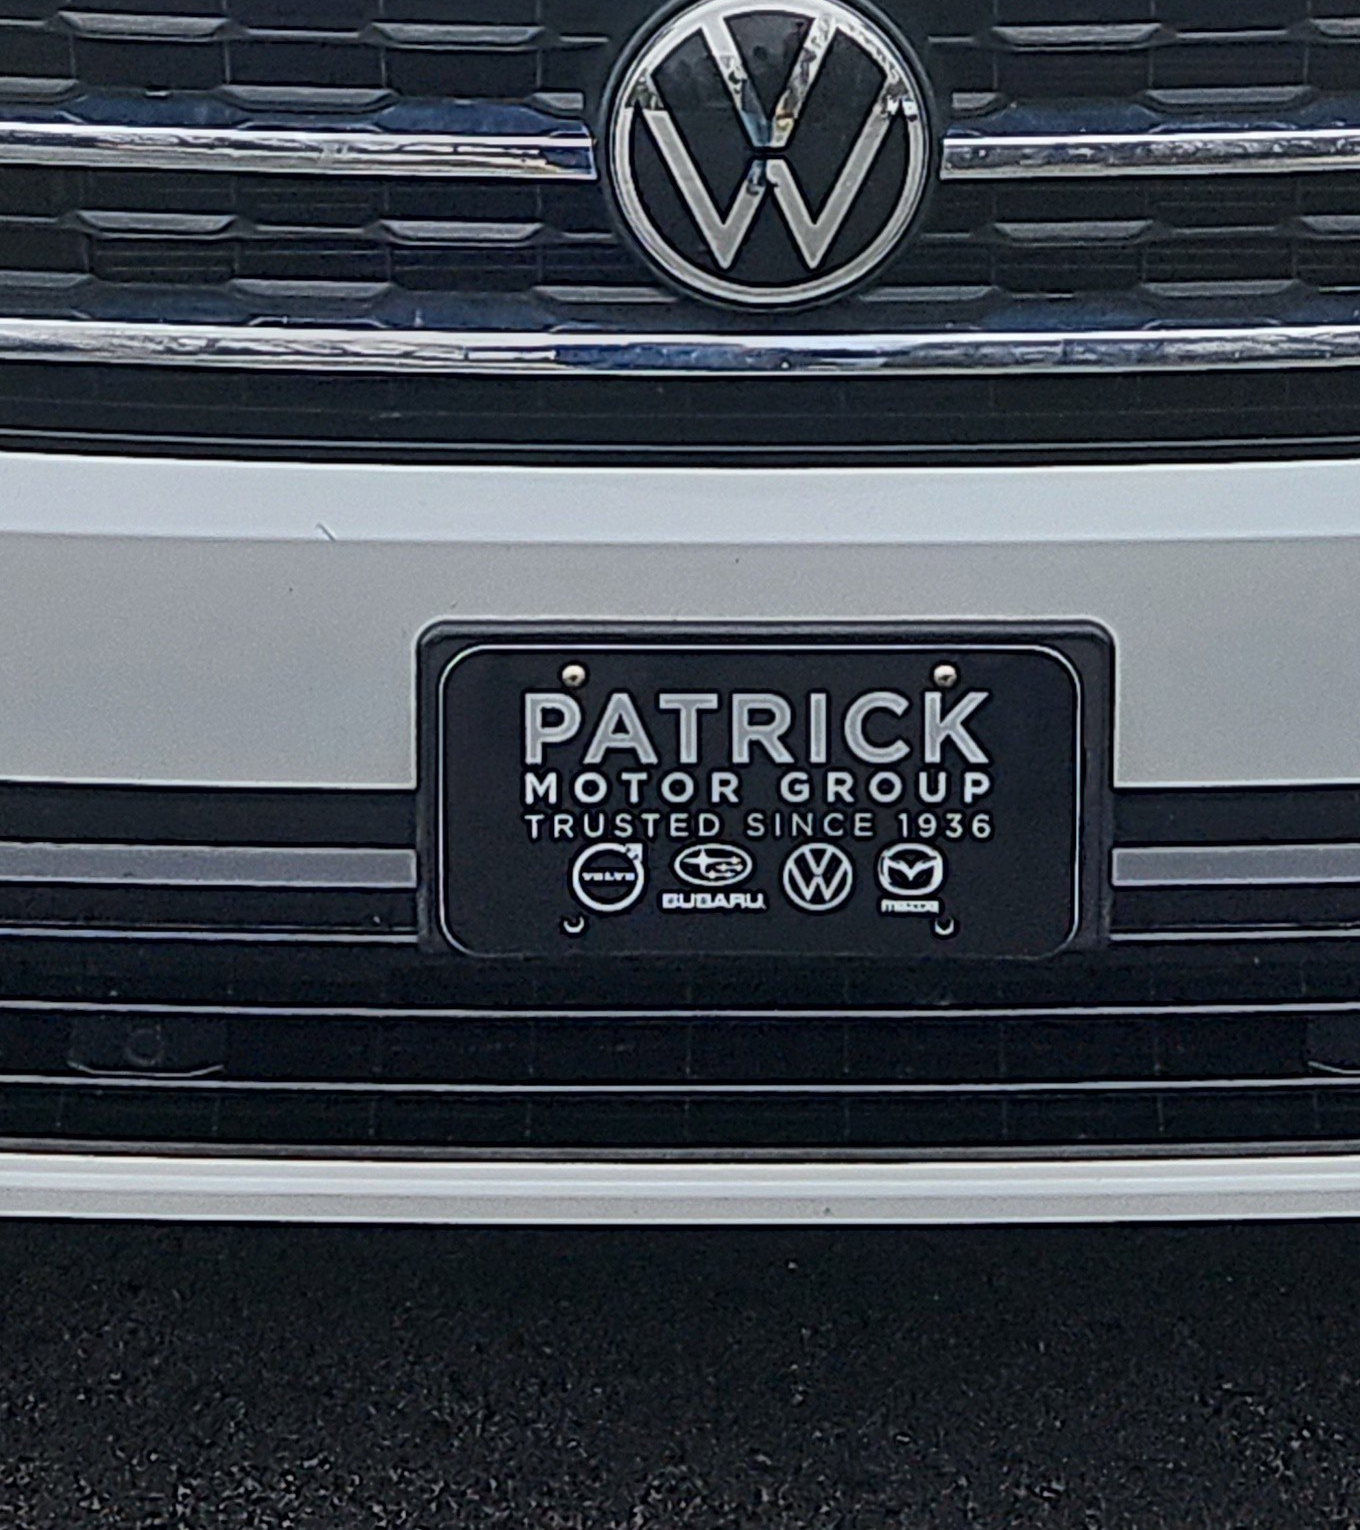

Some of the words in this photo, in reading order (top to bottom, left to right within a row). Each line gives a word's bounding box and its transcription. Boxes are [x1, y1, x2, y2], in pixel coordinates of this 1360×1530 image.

[524, 691, 990, 764] PATRICK
[524, 771, 740, 805] MOTOR
[780, 771, 991, 803] GROUP
[524, 812, 721, 839] TRUSTED
[746, 812, 874, 838] SINCE
[898, 812, 992, 838] 1936
